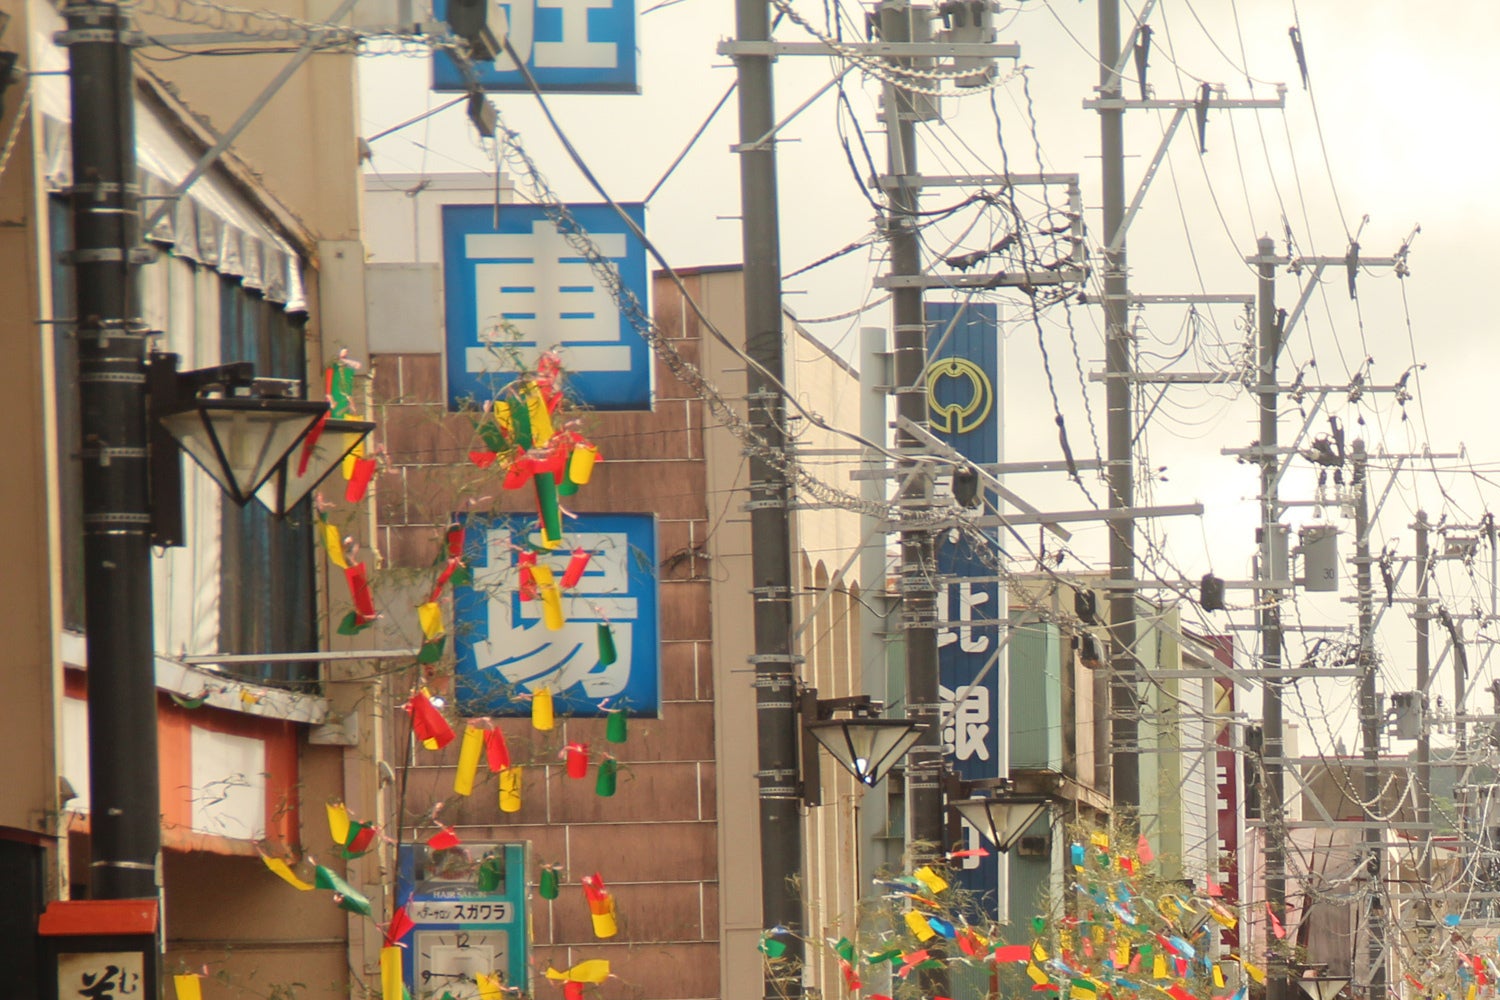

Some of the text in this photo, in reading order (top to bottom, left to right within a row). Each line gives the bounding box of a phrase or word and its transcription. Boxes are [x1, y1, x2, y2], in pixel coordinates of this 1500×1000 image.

[1323, 568, 1335, 580] 30
[433, 890, 456, 899] HAIR
[454, 904, 505, 920] スガワラ
